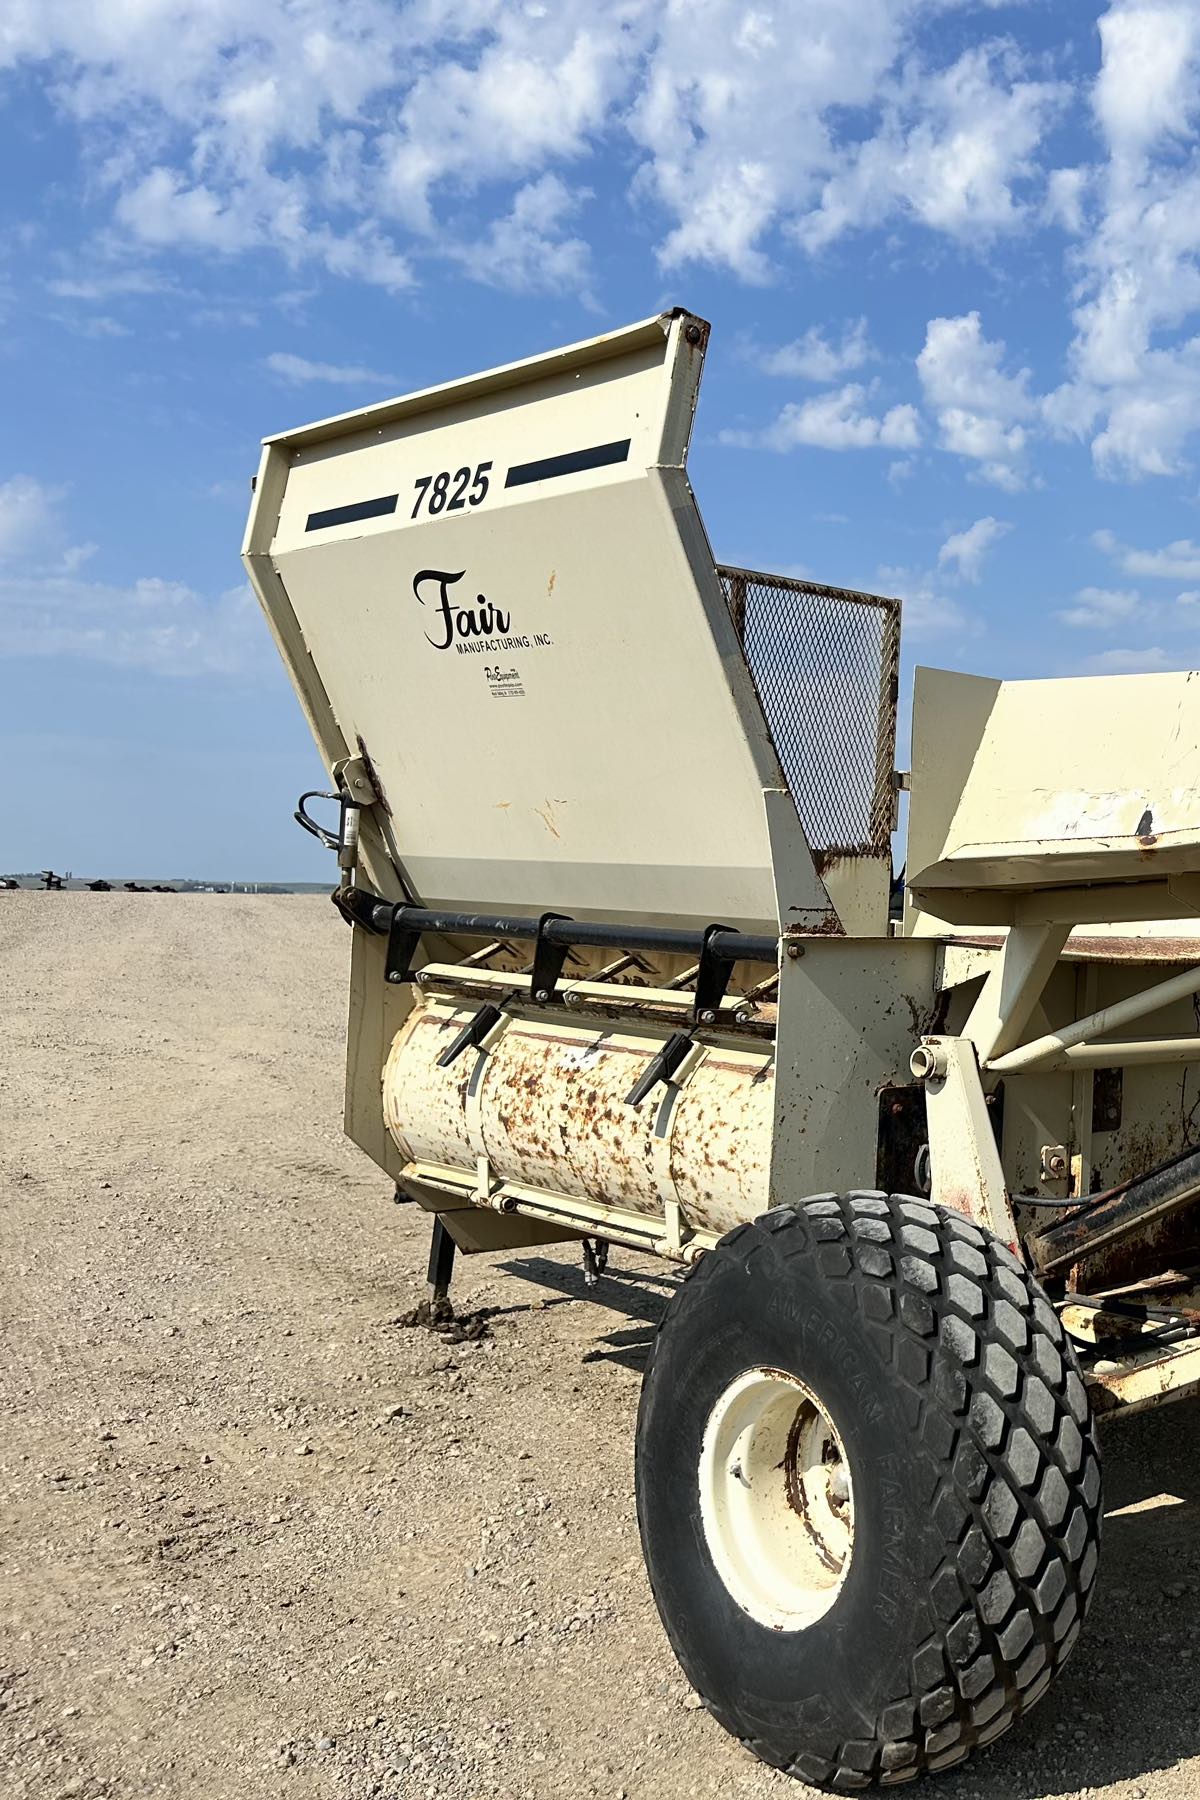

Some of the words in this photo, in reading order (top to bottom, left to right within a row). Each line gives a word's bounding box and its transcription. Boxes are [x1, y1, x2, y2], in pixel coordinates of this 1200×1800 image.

[411, 461, 493, 519] 7825
[413, 569, 510, 650] Fair
[456, 636, 533, 655] MANUFACTURING,
[534, 633, 554, 648] INC.
